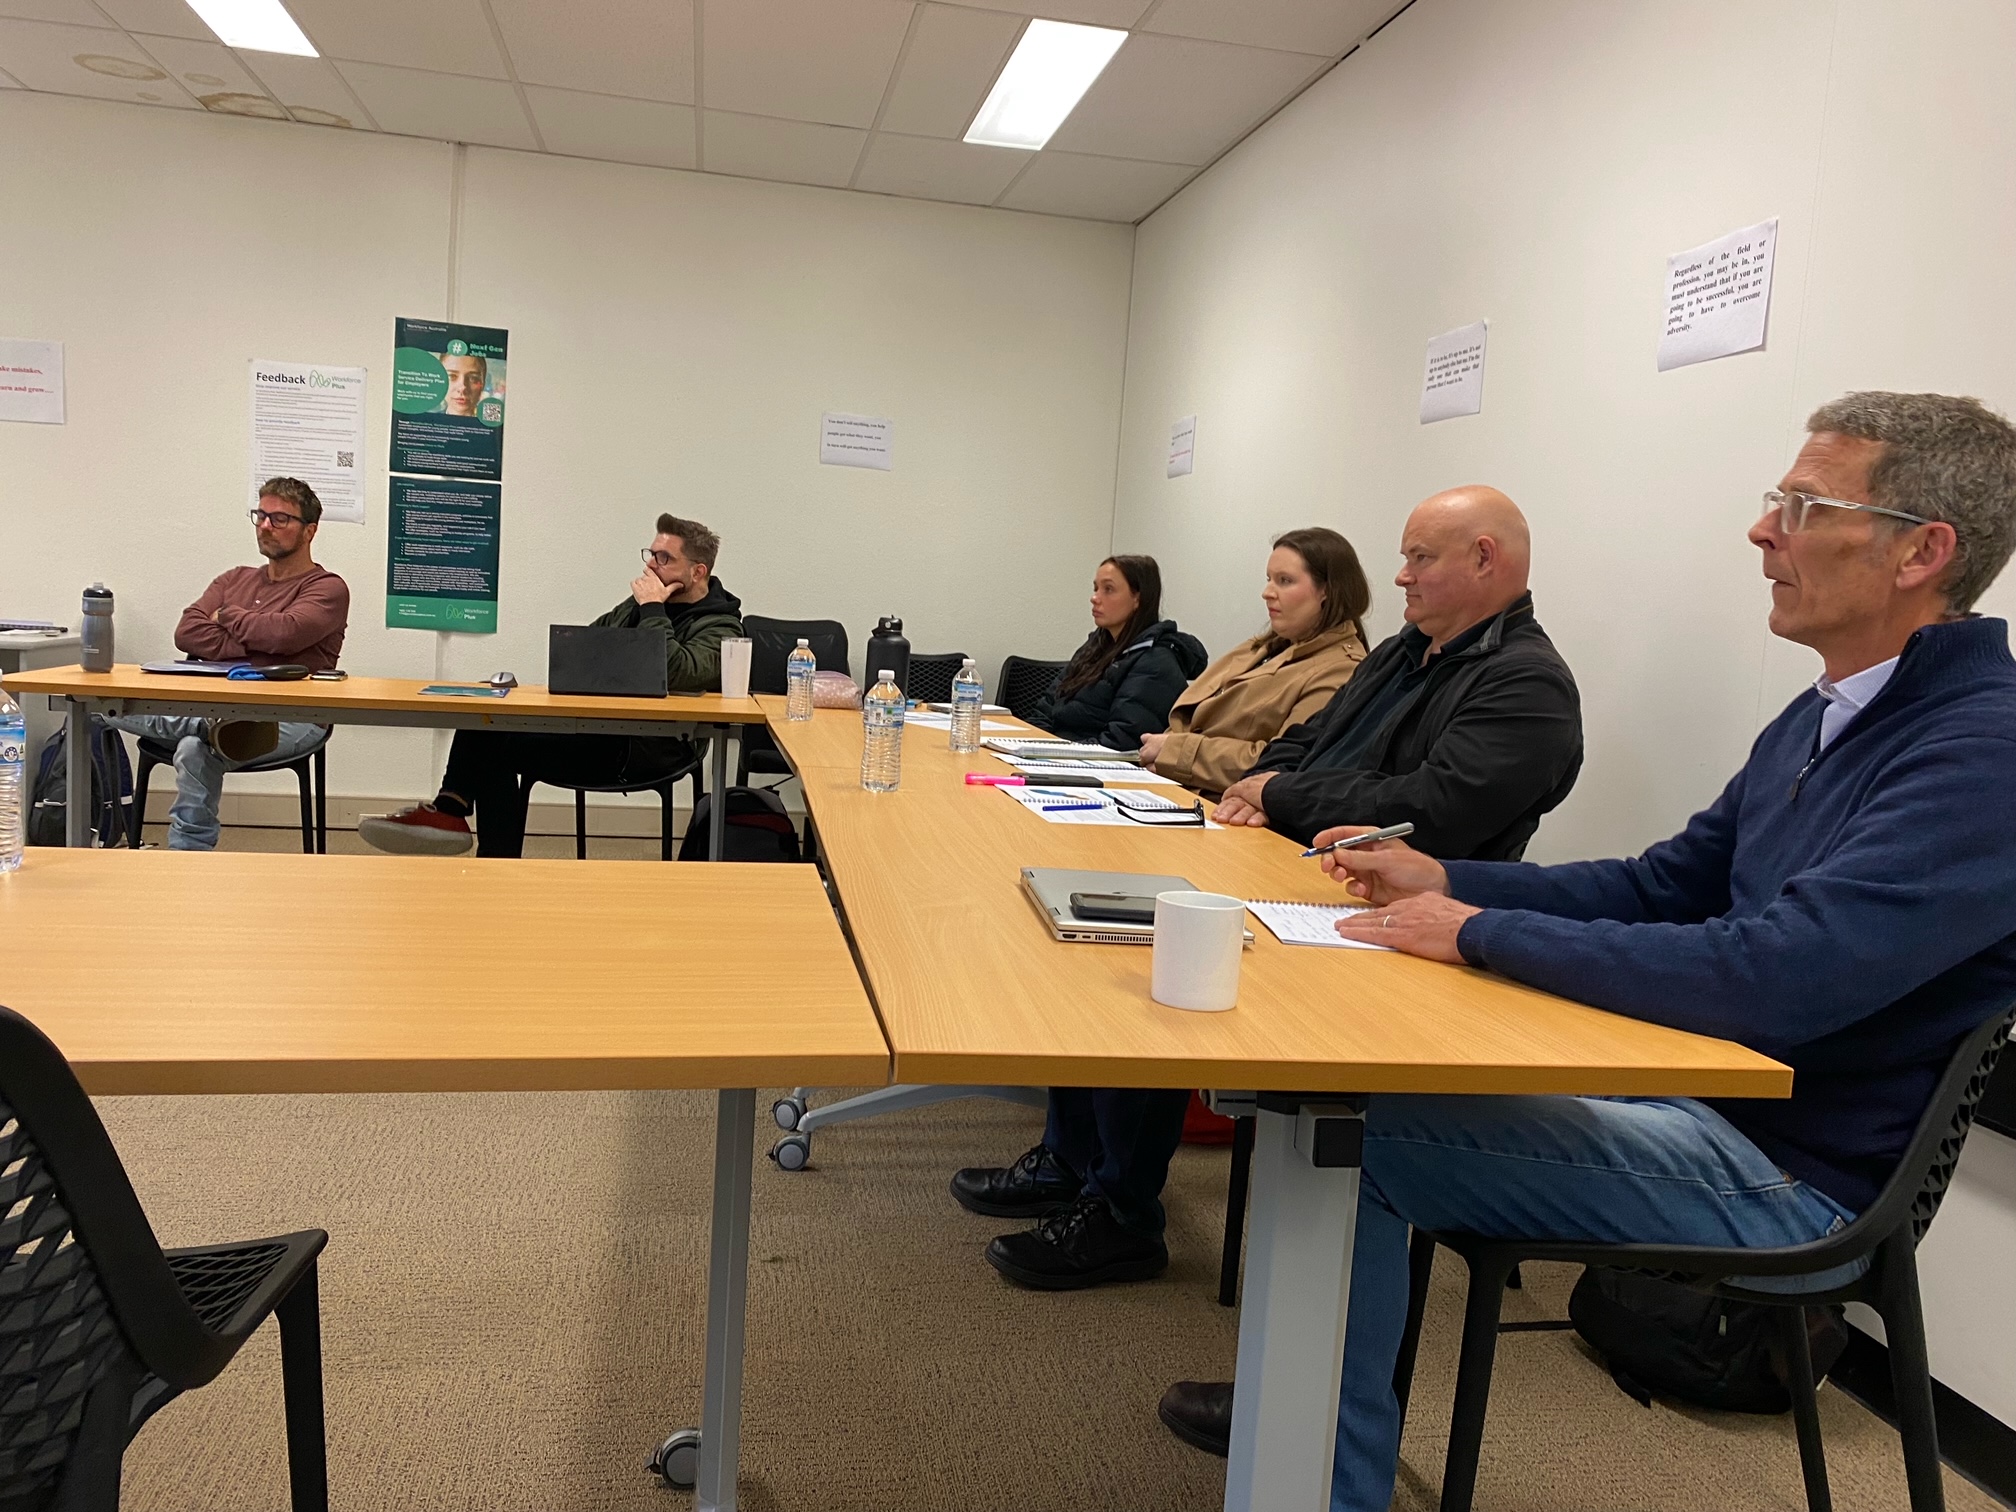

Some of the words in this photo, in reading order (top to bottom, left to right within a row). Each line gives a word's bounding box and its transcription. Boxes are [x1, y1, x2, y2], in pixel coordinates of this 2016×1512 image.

[1672, 275, 1701, 291] profession,
[1704, 271, 1714, 280] you
[1717, 266, 1728, 277] may
[1753, 253, 1764, 264] you
[1674, 263, 1702, 277] Regardless
[1708, 256, 1714, 265] of
[1721, 252, 1730, 261] the
[1737, 244, 1750, 254] field
[1670, 303, 1684, 314] going
[1696, 297, 1703, 305] be
[1706, 286, 1735, 302] successful,
[1738, 283, 1749, 294] you
[1672, 291, 1684, 300] must
[1687, 278, 1717, 296] understand
[1720, 275, 1731, 286] that
[1733, 272, 1737, 280] if
[1739, 270, 1750, 281] you
[1754, 266, 1763, 274] are
[1668, 315, 1682, 326] going
[1701, 305, 1714, 314] have
[1733, 291, 1760, 305] overcome
[1667, 324, 1692, 336] adversity.
[256, 372, 306, 384] Feedback
